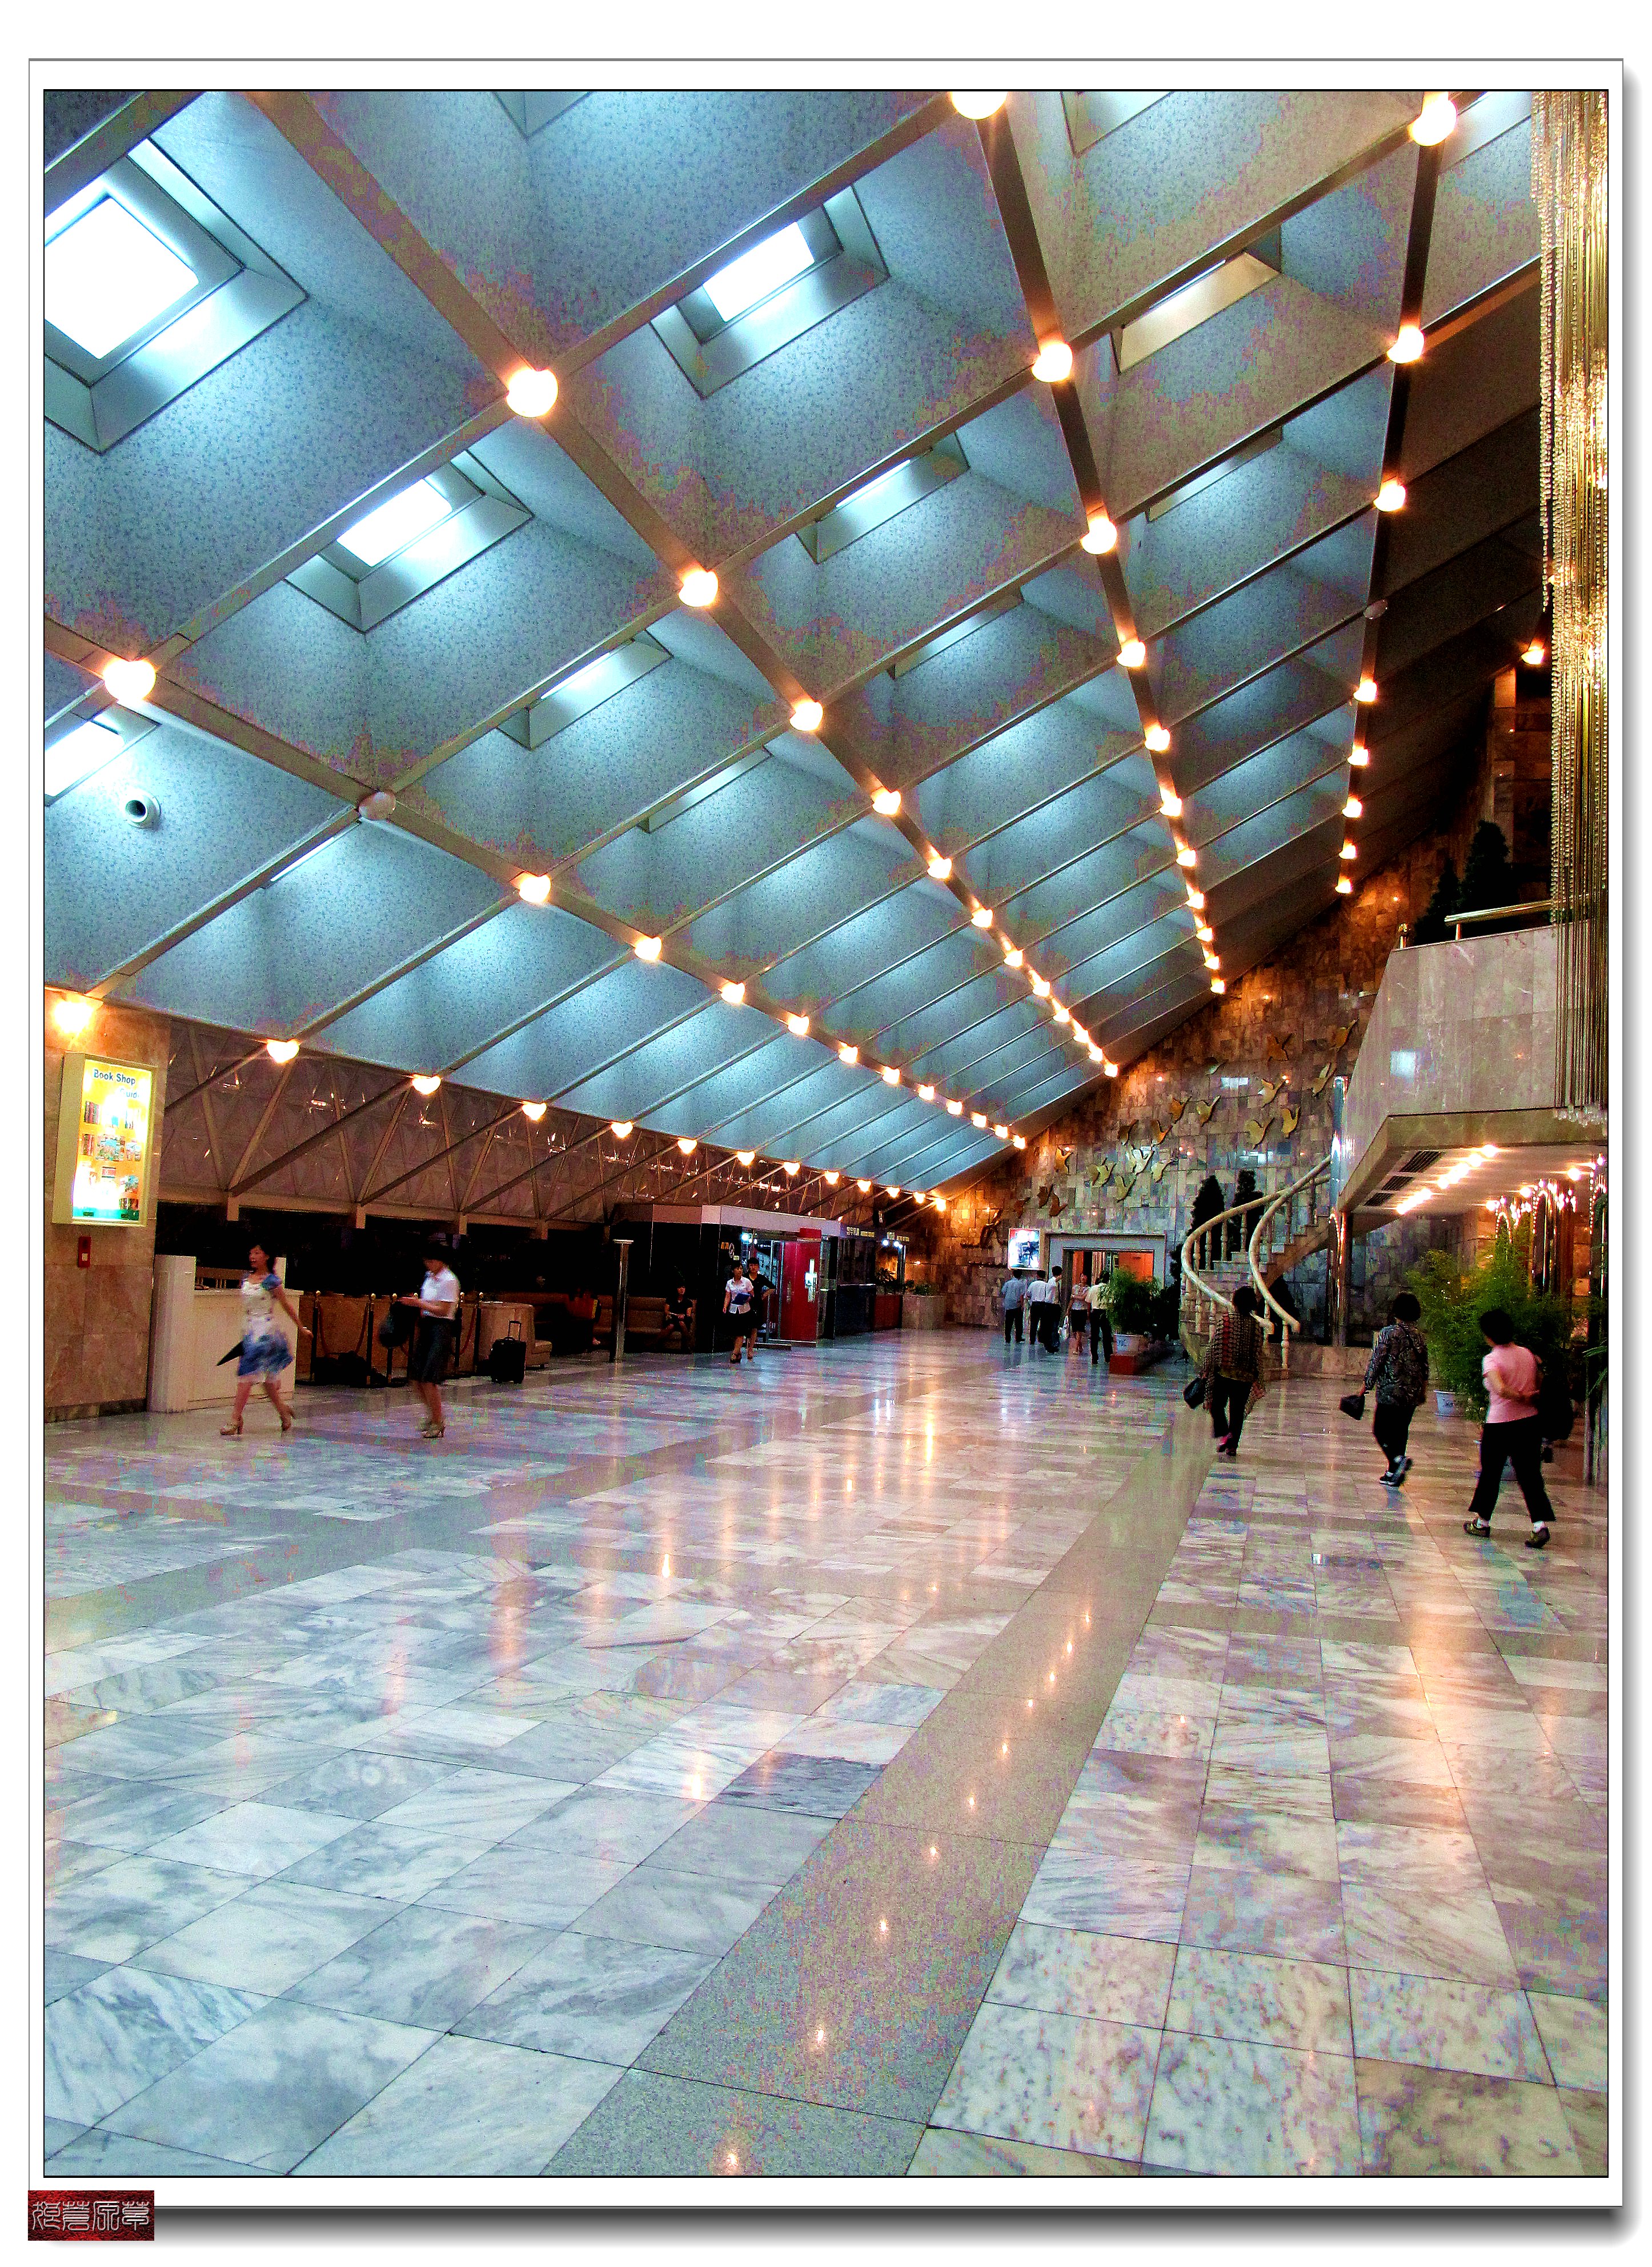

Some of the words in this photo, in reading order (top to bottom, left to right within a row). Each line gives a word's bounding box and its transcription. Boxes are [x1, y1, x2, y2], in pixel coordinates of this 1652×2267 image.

[94, 1069, 113, 1081] Book
[116, 1073, 135, 1086] Shop
[120, 1088, 140, 1099] uid
